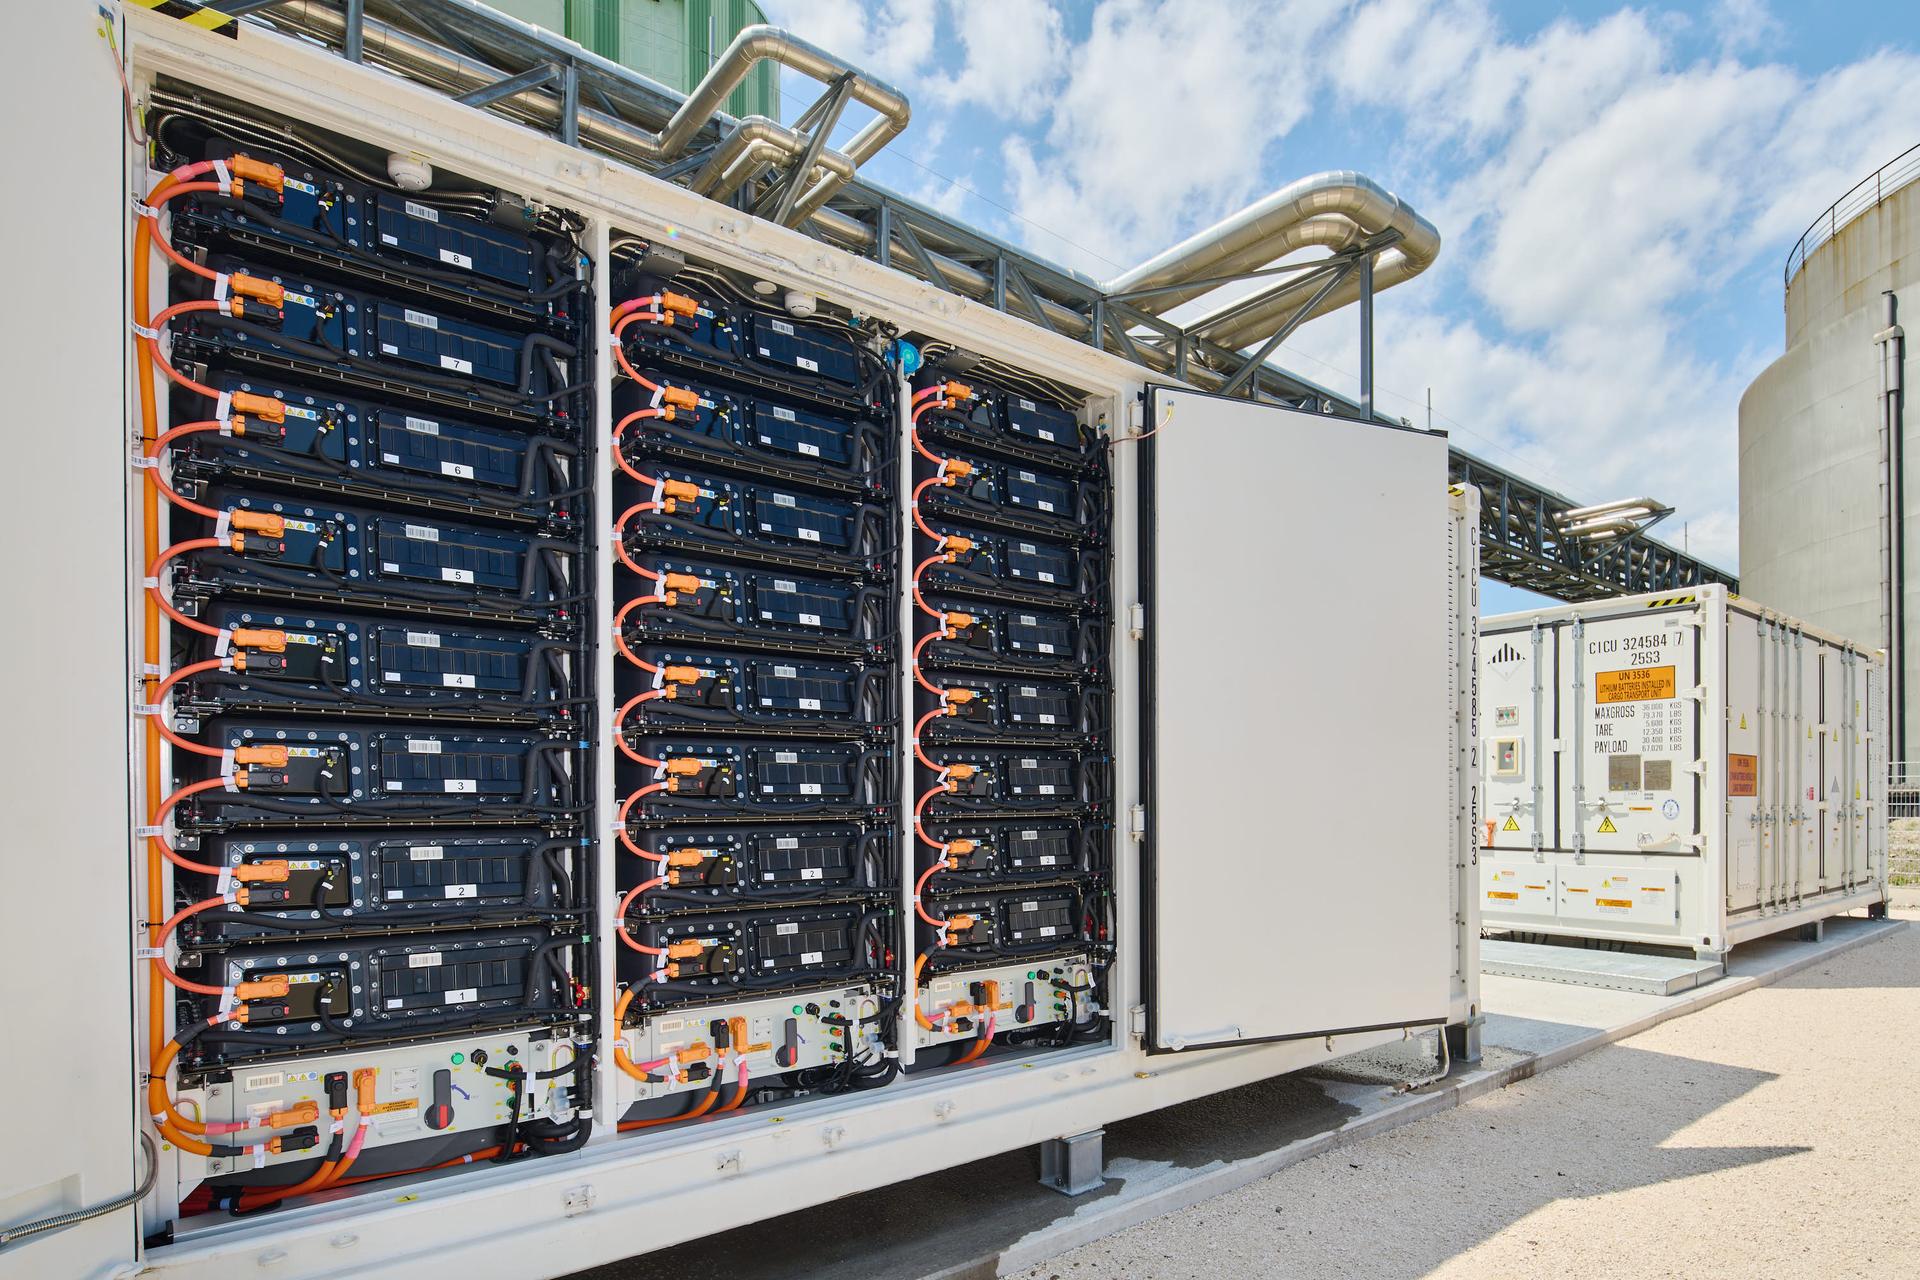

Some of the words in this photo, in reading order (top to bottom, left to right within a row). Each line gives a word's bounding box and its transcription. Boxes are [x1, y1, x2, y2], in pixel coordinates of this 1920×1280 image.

[454, 254, 460, 264] 8
[454, 360, 460, 368] 7
[455, 466, 462, 474] 6
[455, 571, 461, 580] 5
[1589, 640, 1617, 654] CICU
[1623, 634, 1666, 650] 324584
[1675, 632, 1682, 645] 7
[1619, 672, 1630, 680] UN
[1633, 670, 1650, 680] 3536
[456, 676, 462, 685] 4
[1600, 684, 1617, 693] LITHIUM
[1619, 681, 1640, 691] BATTERIES
[1642, 680, 1664, 689] INSTALLED
[1666, 679, 1671, 688] IN
[1608, 691, 1623, 700] CARGO
[1624, 690, 1649, 700] TRANSPORT
[1651, 689, 1662, 697] UNIT
[1595, 705, 1635, 719] MAXGROSS
[1596, 724, 1614, 736] TARE
[1595, 740, 1628, 753] PAYLOAD
[1472, 747, 1477, 766] 2
[458, 782, 464, 790] 3
[458, 888, 464, 896] 2
[460, 991, 464, 999] 1
